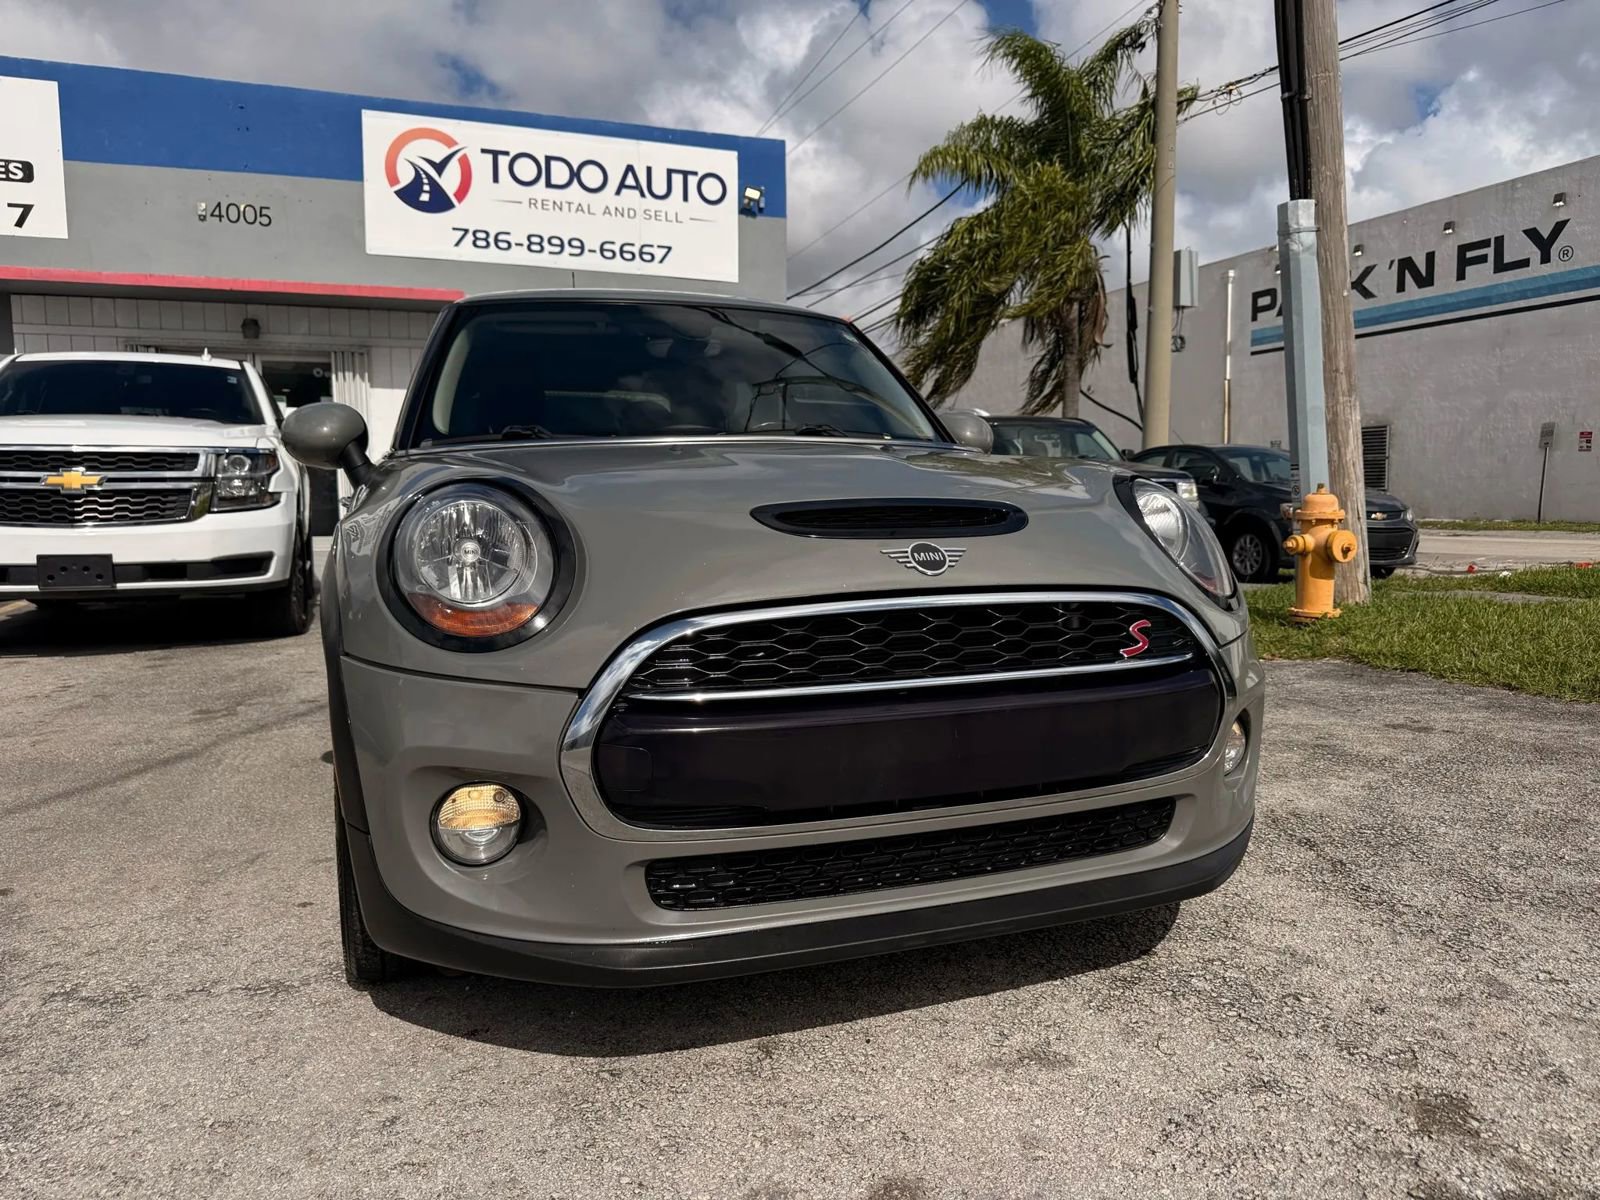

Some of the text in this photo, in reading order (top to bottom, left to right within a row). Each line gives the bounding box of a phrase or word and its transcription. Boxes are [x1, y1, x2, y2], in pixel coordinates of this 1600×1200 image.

[480, 148, 727, 206] TODO AUTO
[209, 201, 272, 227] 4005
[528, 198, 684, 223] RENTAL AND SELL
[451, 227, 673, 264] 786-899-6667
[1251, 264, 1378, 321] PK
[913, 551, 944, 561] MINI
[1119, 619, 1152, 658] S
